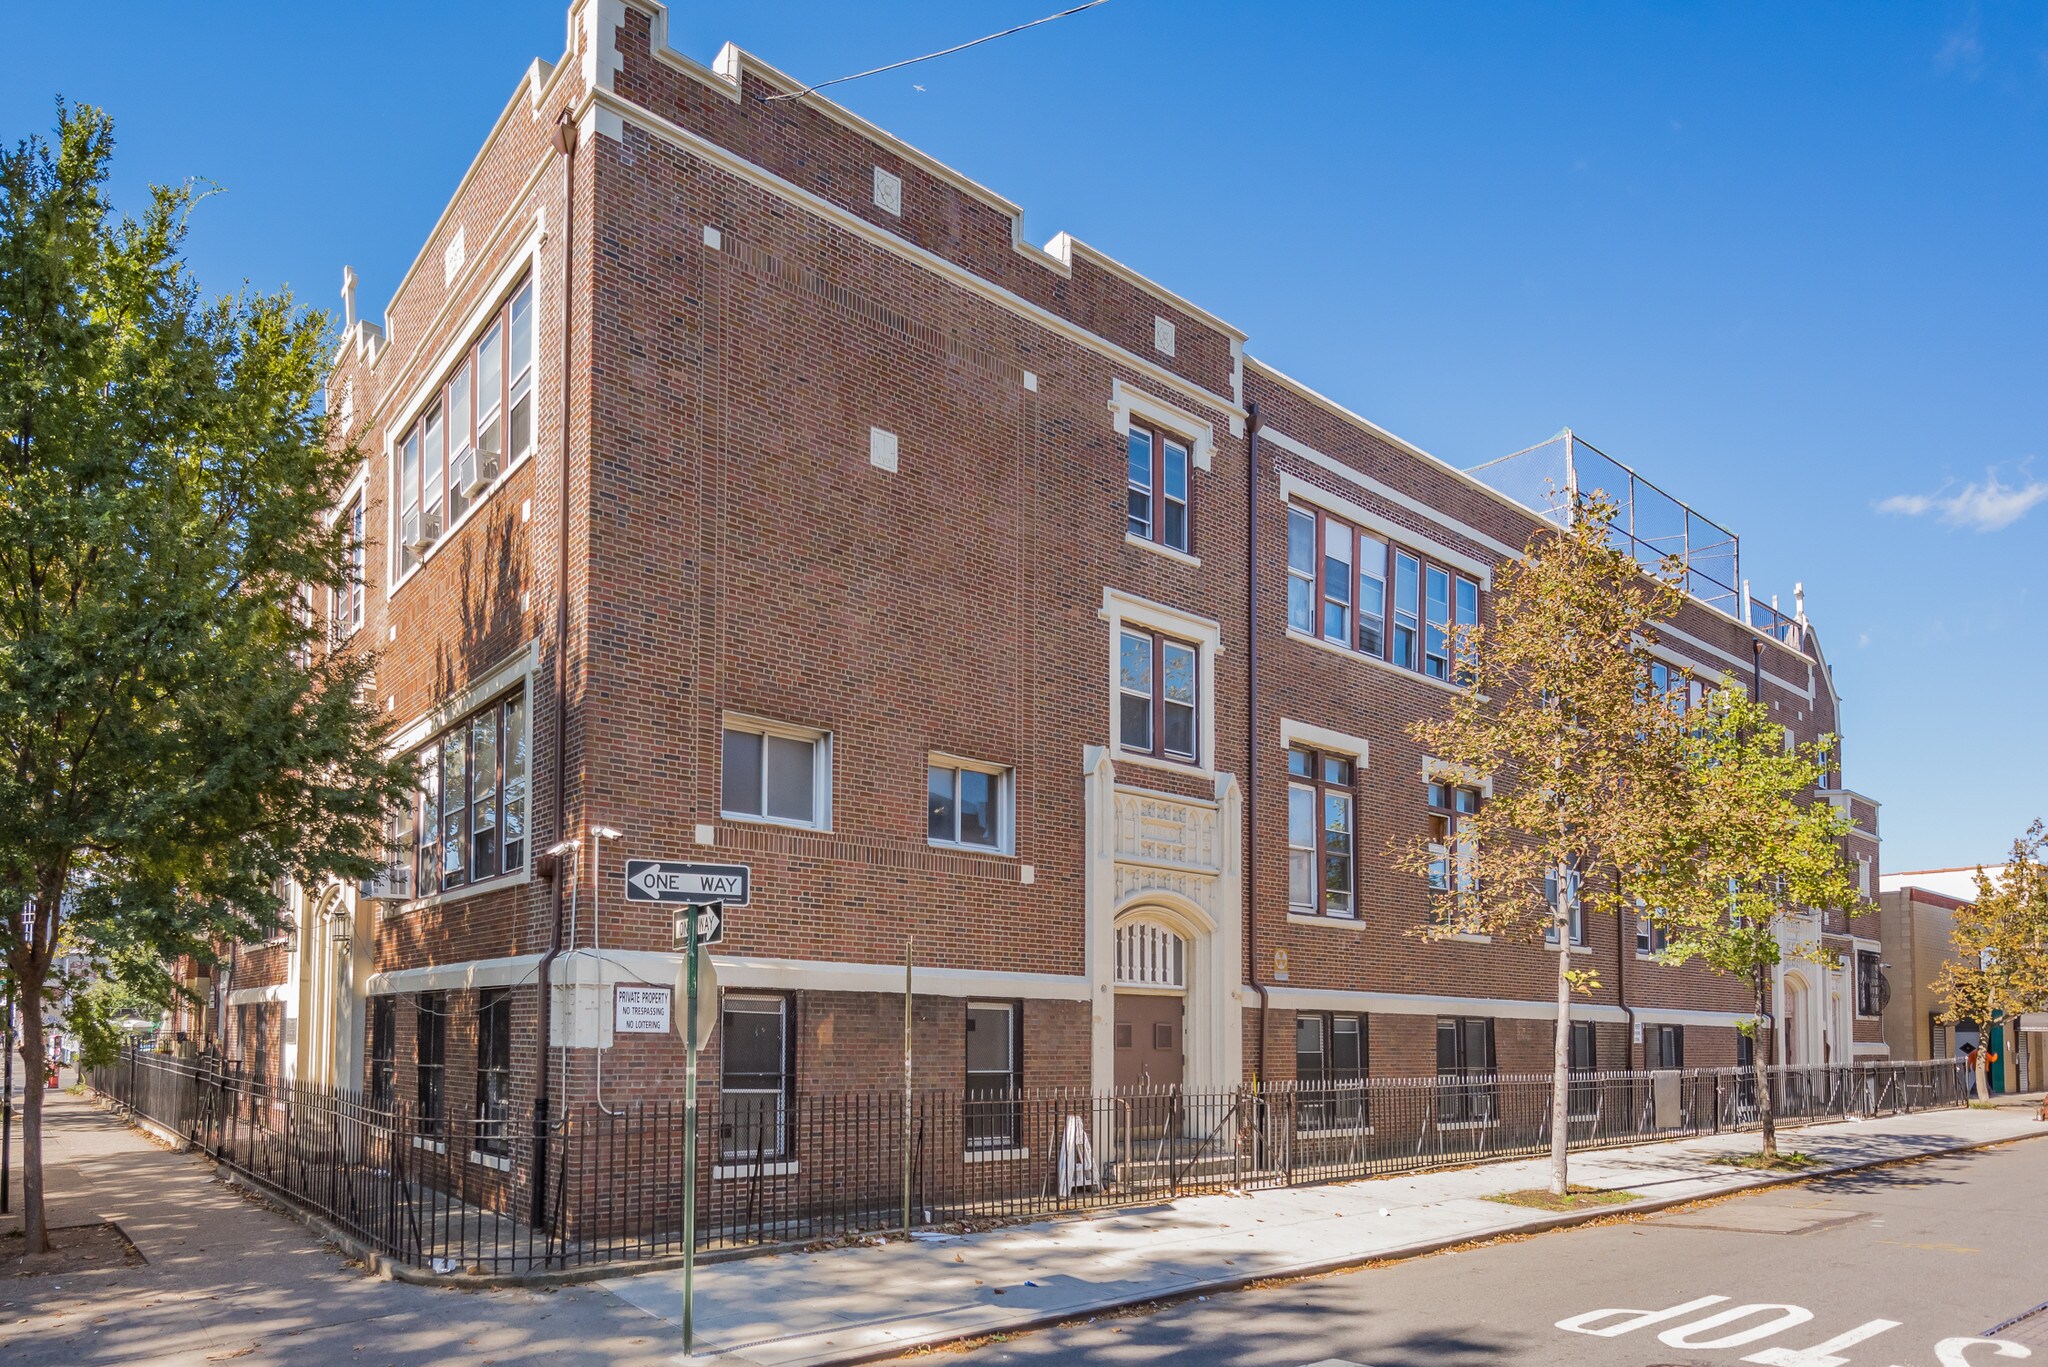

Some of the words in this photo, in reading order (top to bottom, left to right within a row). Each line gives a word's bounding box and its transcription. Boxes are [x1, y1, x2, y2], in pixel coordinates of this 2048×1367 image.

[643, 873, 680, 890] ONE
[700, 876, 738, 893] WAY
[679, 920, 688, 936] ON
[698, 915, 715, 933] WAY
[618, 991, 640, 1003] PRIVATE
[641, 992, 669, 1004] PROPERTY
[622, 1006, 631, 1015] NO
[632, 1007, 665, 1016] TRESPASSING
[626, 1020, 634, 1029] NO
[635, 1021, 661, 1029] LOITERING
